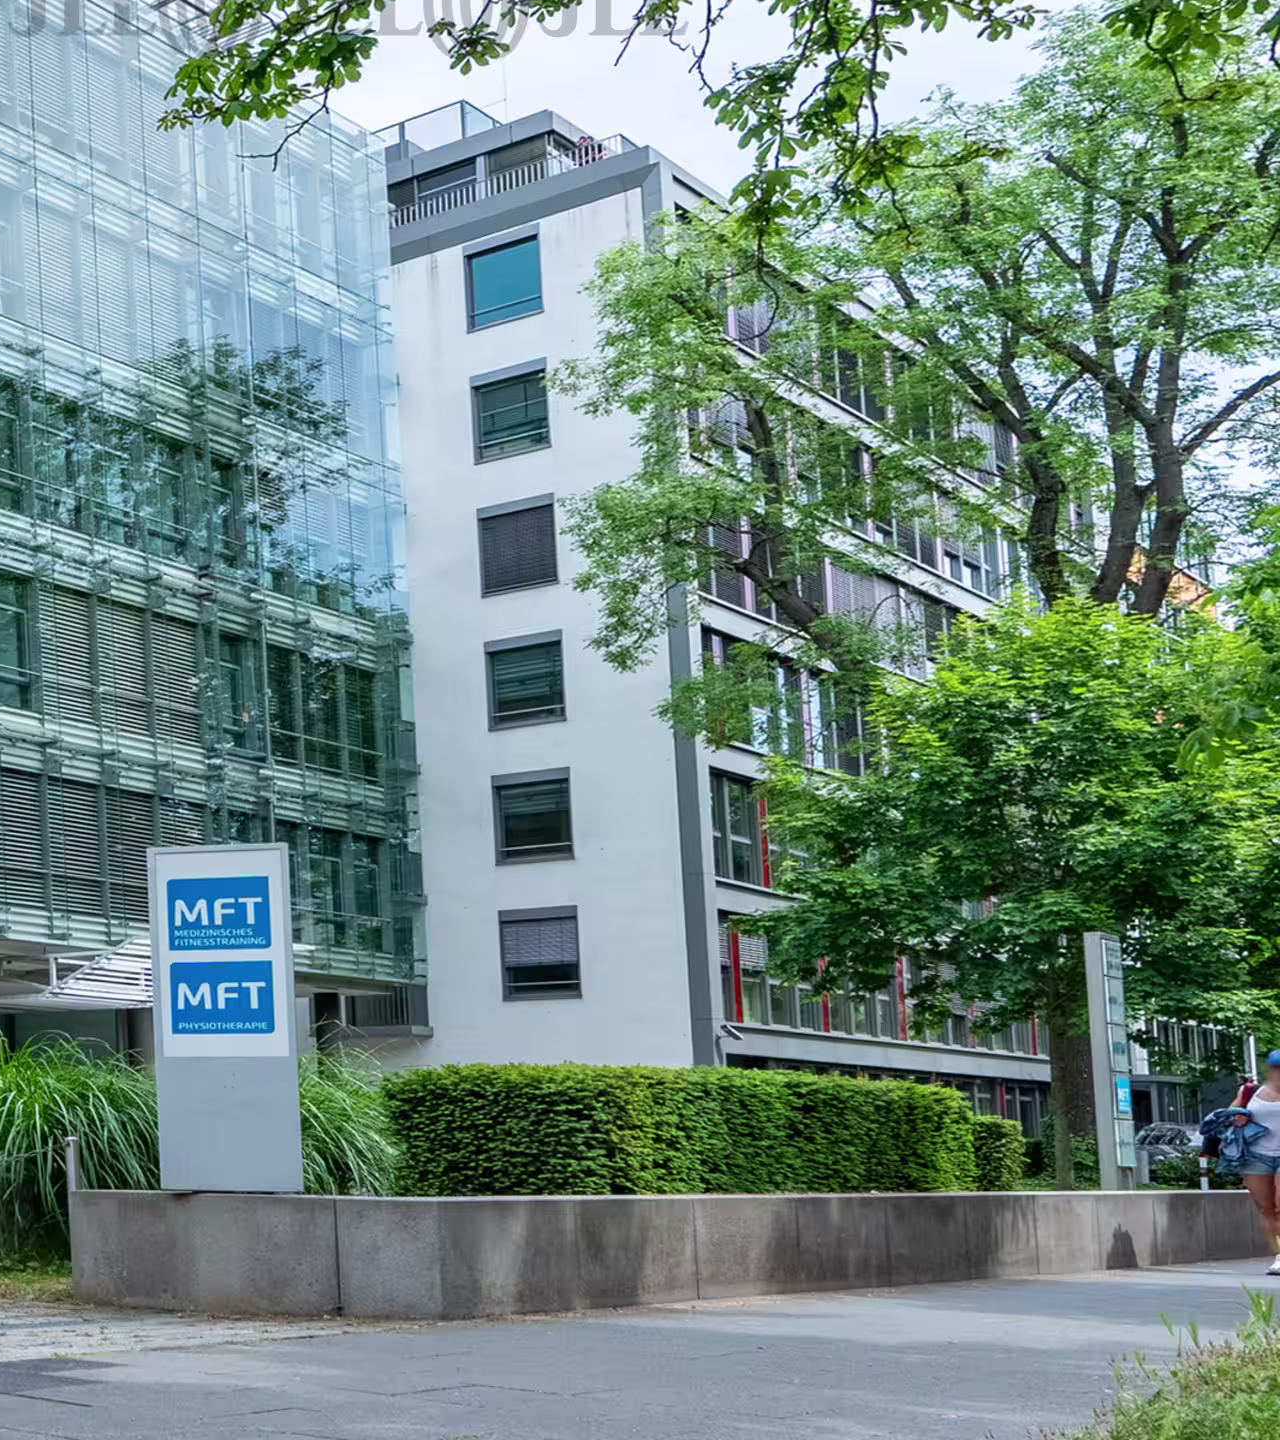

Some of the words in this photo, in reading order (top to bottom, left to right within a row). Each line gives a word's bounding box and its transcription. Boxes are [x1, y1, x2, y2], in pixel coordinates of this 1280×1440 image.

[174, 897, 263, 926] MFT
[174, 927, 253, 938] MEDIZINISCHES
[174, 936, 266, 947] FITNESSTRAINING
[177, 981, 266, 1010] MFT
[178, 1021, 268, 1030] PHYSIOTHERAPIE
